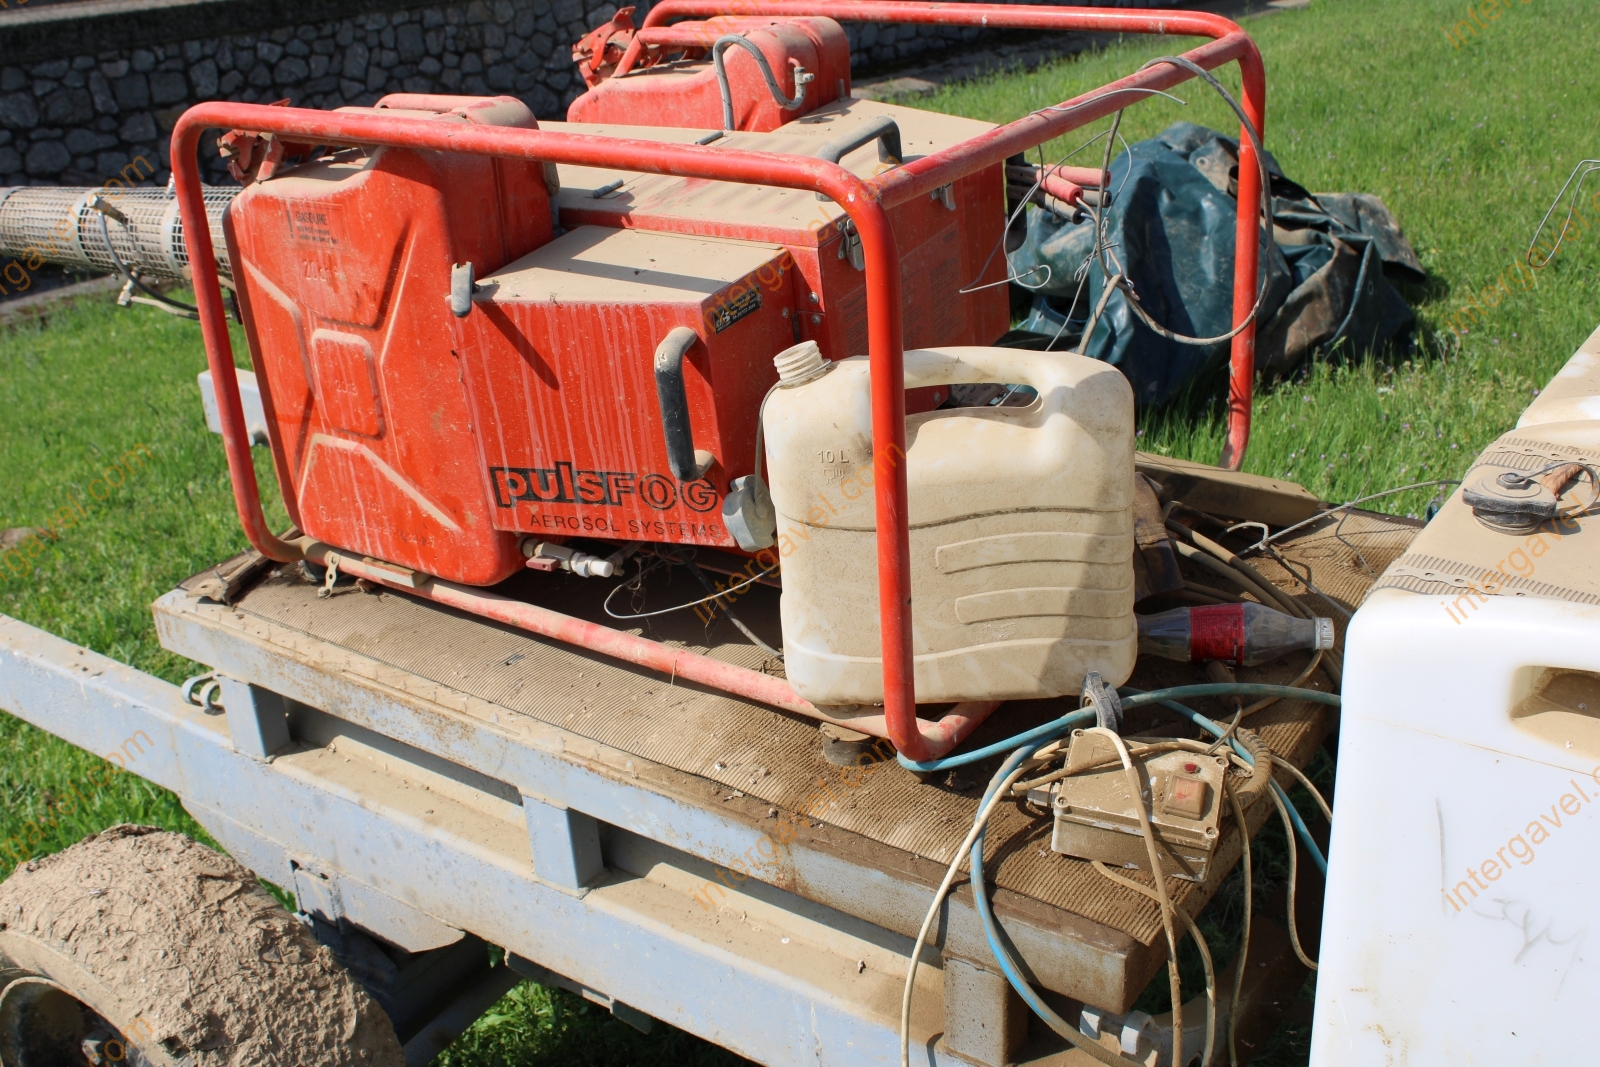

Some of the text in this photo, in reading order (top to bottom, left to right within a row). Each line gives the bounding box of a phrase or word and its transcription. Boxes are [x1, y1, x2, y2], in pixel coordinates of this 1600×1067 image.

[817, 449, 850, 464] 10 L
[529, 514, 722, 539] AEROSOL SYSTEMS
